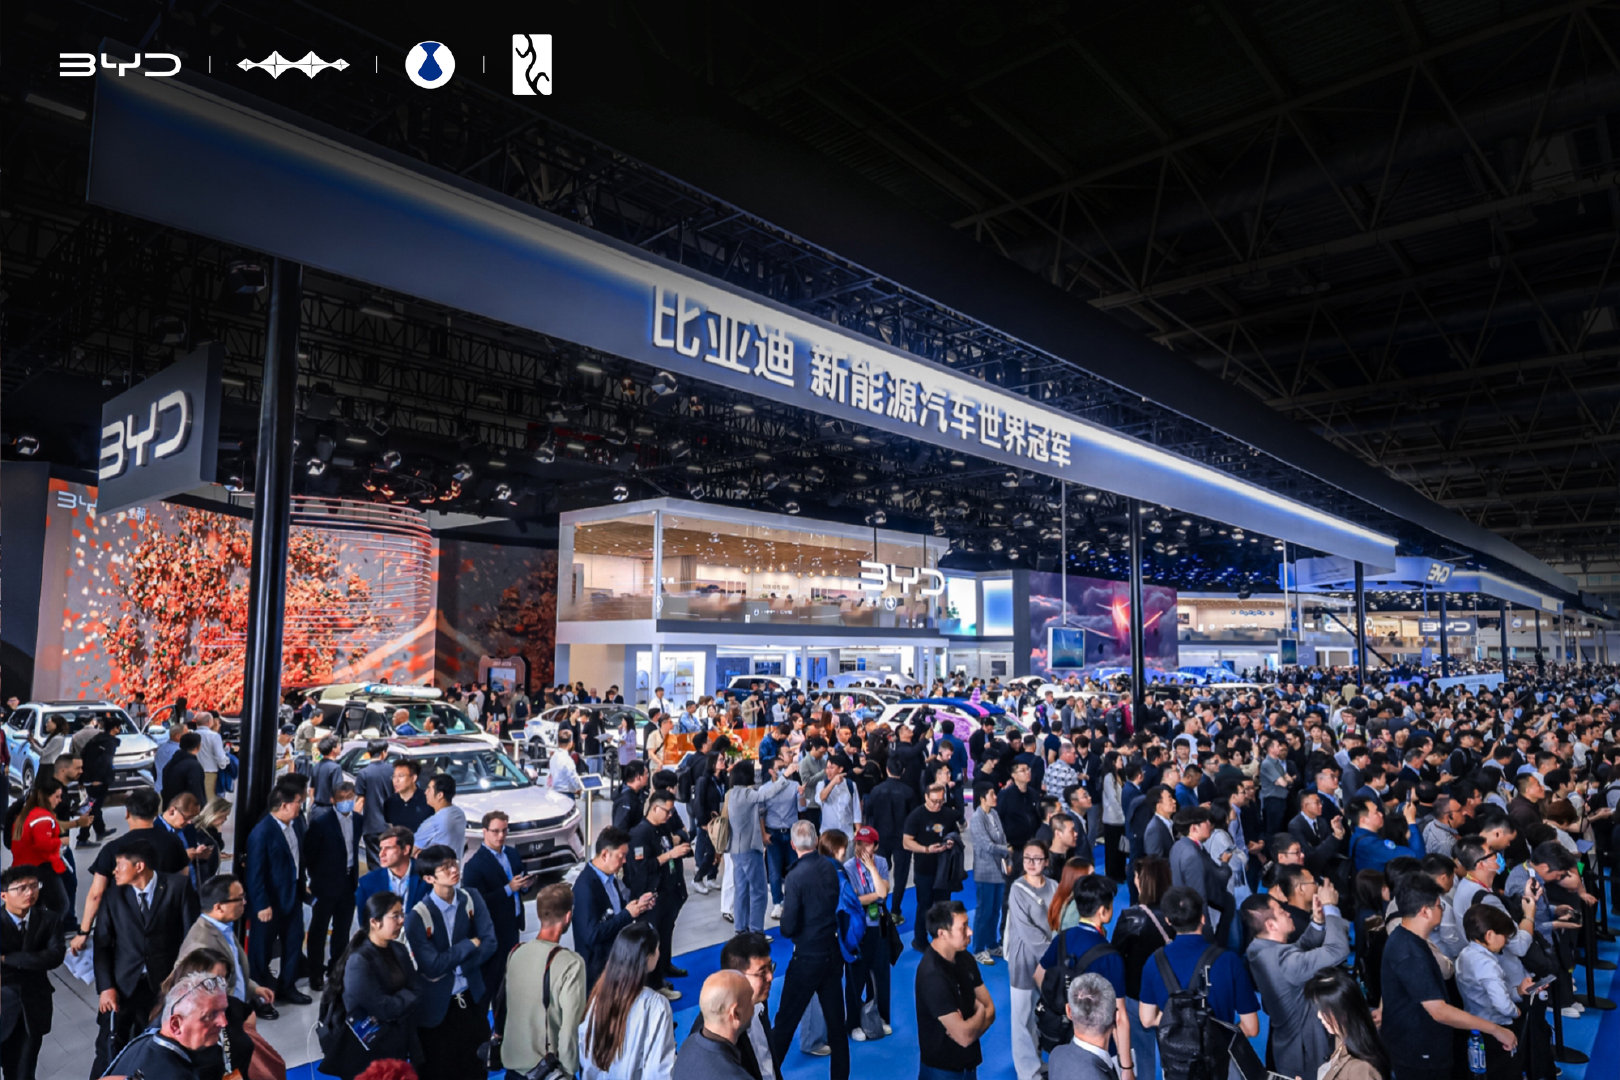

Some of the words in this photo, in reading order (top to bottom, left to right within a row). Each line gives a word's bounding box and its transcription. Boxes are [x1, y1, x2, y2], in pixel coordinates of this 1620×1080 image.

[652, 284, 795, 388] 比亚迪
[809, 343, 1072, 468] 新能源汽车世界冠军
[98, 389, 192, 480] BYD
[56, 490, 98, 513] BY
[860, 560, 945, 596] BYD
[1427, 562, 1450, 584] BYD
